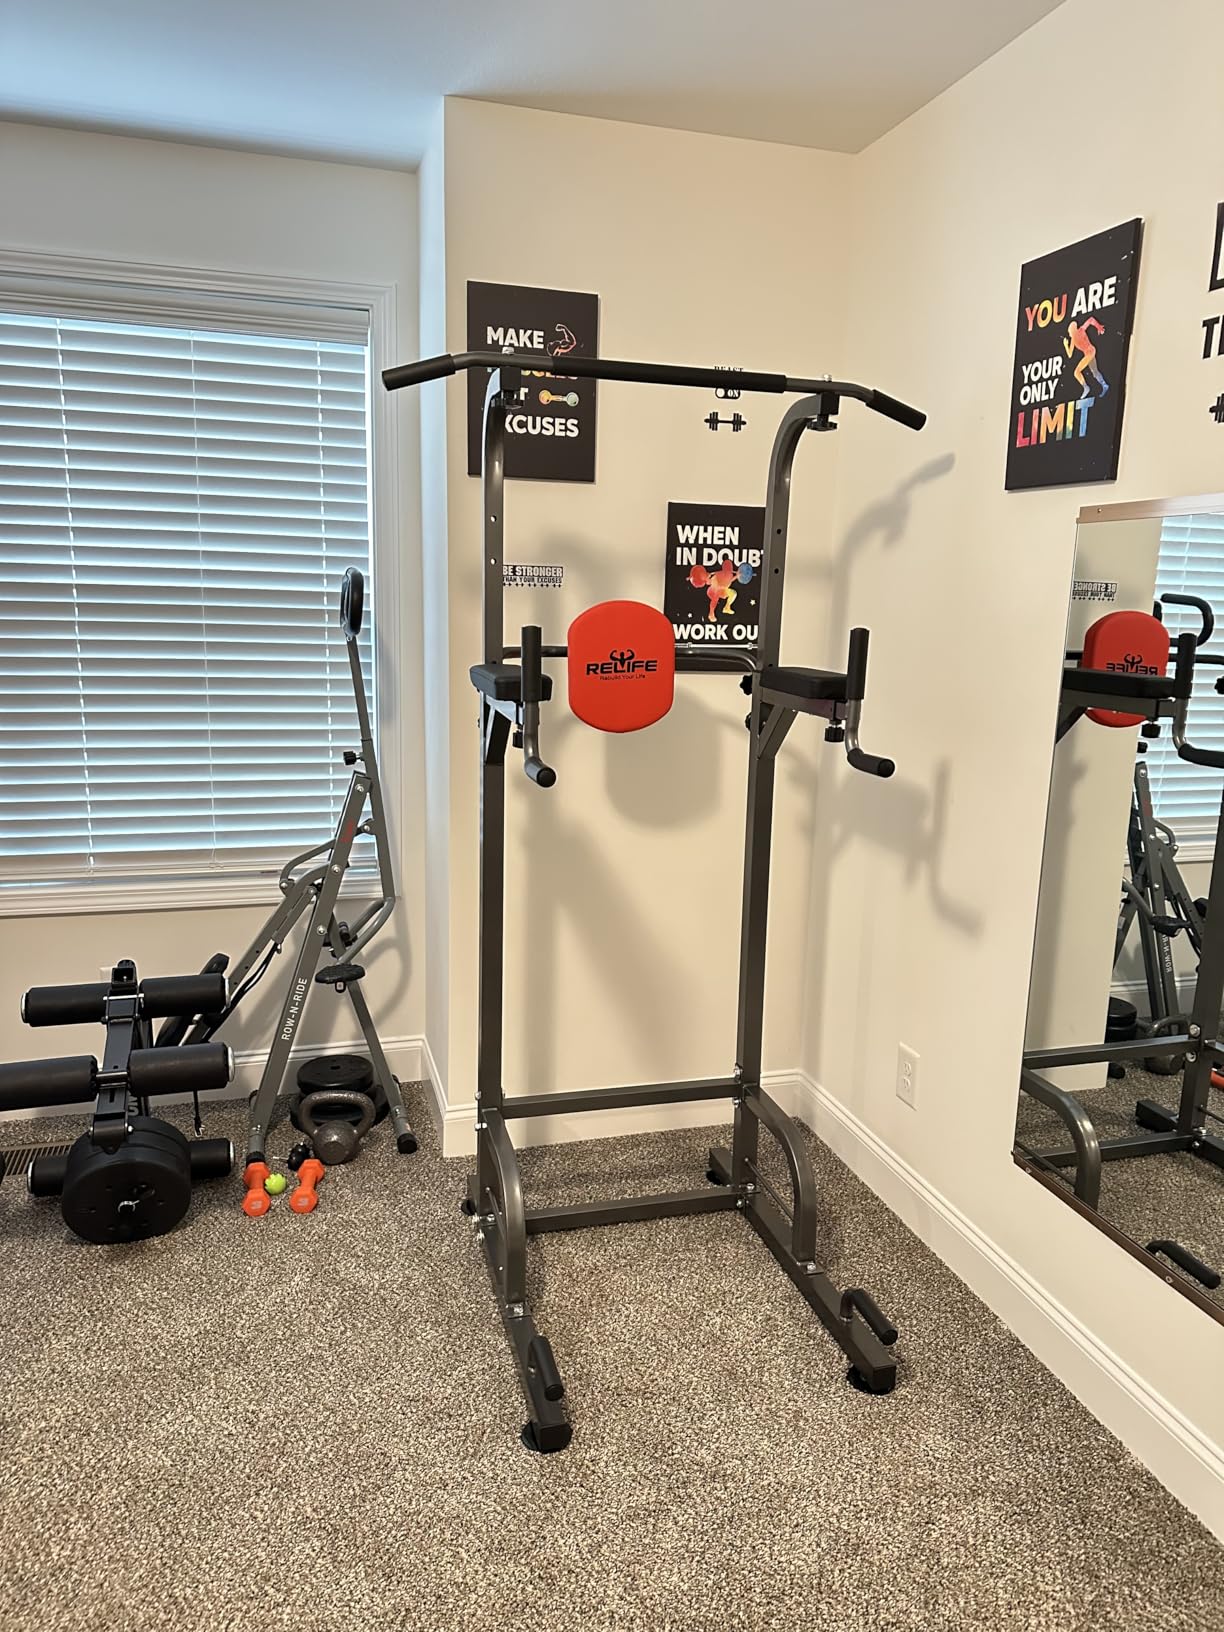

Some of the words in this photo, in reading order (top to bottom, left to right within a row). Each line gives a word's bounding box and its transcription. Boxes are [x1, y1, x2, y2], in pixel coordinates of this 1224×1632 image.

[1025, 293, 1067, 332] YOU
[1071, 276, 1117, 318] ARE
[487, 326, 544, 349] MAKE
[1022, 356, 1063, 384] YOUR
[1019, 378, 1059, 406] ONLY
[1016, 396, 1095, 448] LIMIT
[676, 525, 739, 545] WHEN
[676, 547, 697, 566] IN
[703, 548, 764, 567] DOUB
[503, 565, 514, 576] BE
[515, 566, 562, 577] STRONGER
[673, 624, 728, 640] WORK
[586, 660, 657, 675] RELIFE
[281, 977, 308, 1041] ROW-N-RIDE
